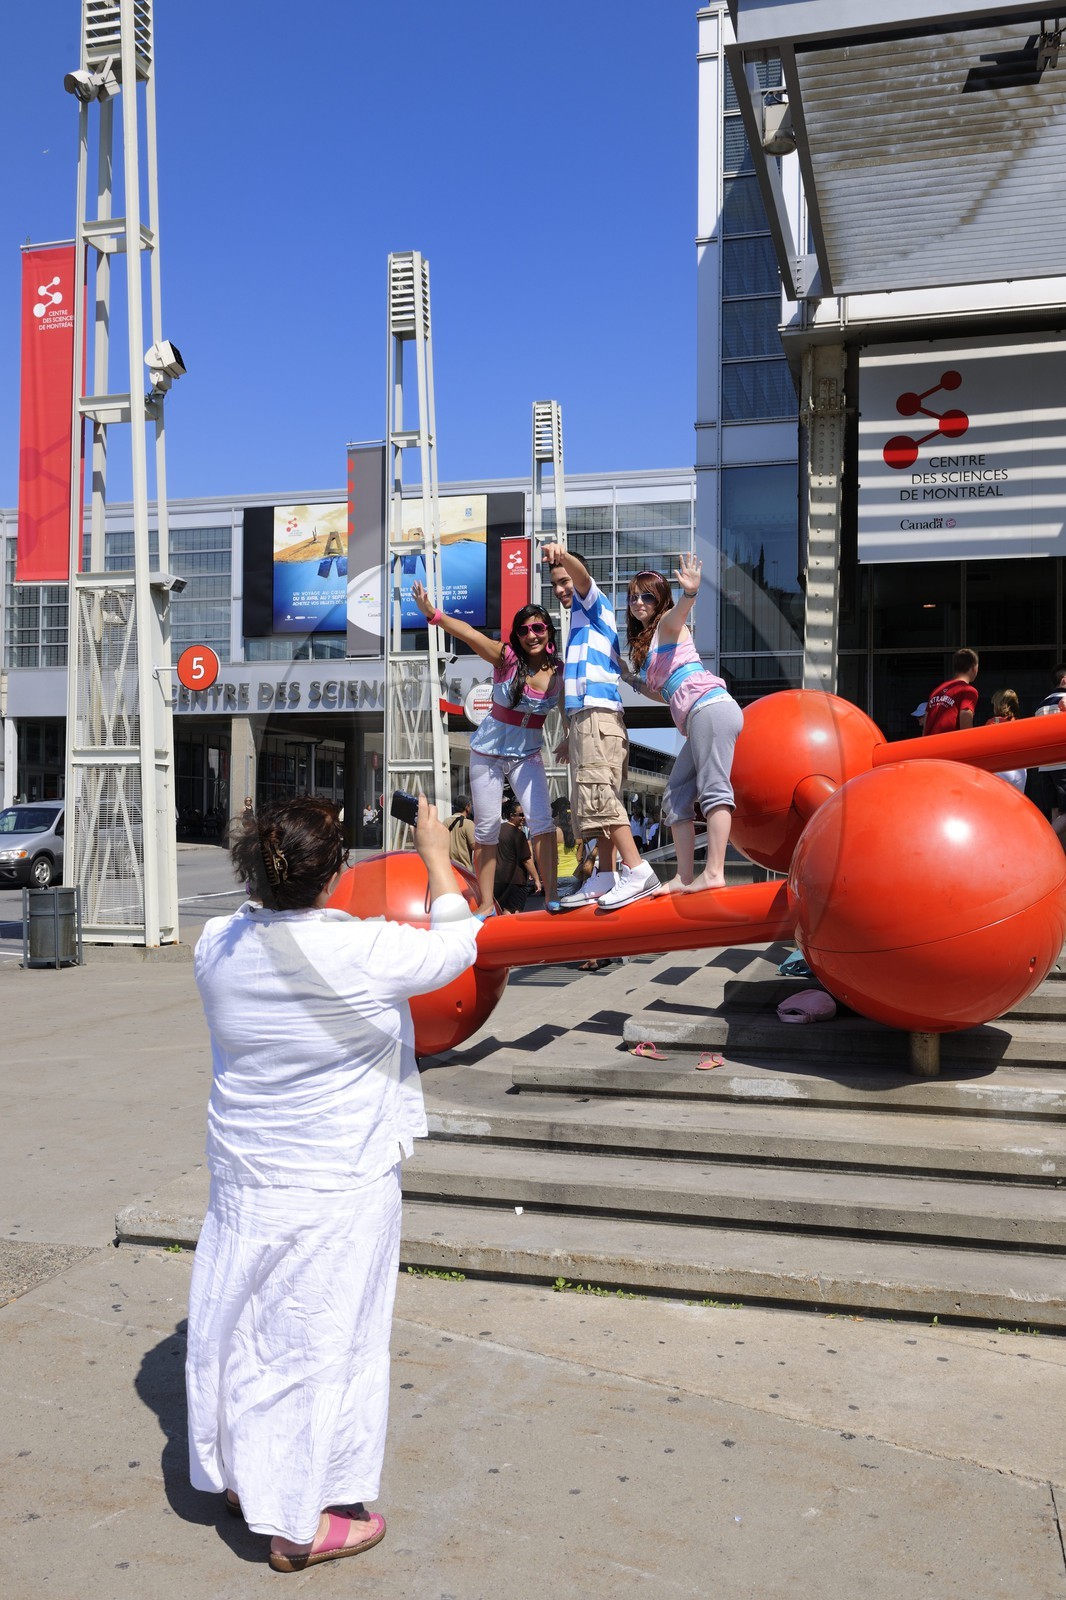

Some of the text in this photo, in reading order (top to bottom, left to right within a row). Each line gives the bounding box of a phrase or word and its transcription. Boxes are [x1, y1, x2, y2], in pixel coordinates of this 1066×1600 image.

[929, 454, 986, 468] CENTRE
[911, 468, 1009, 485] DES SCIENCES
[900, 483, 1003, 501] DE MONTRÉAL
[900, 517, 943, 531] Canada
[191, 656, 205, 680] 5
[258, 681, 301, 702] DES
